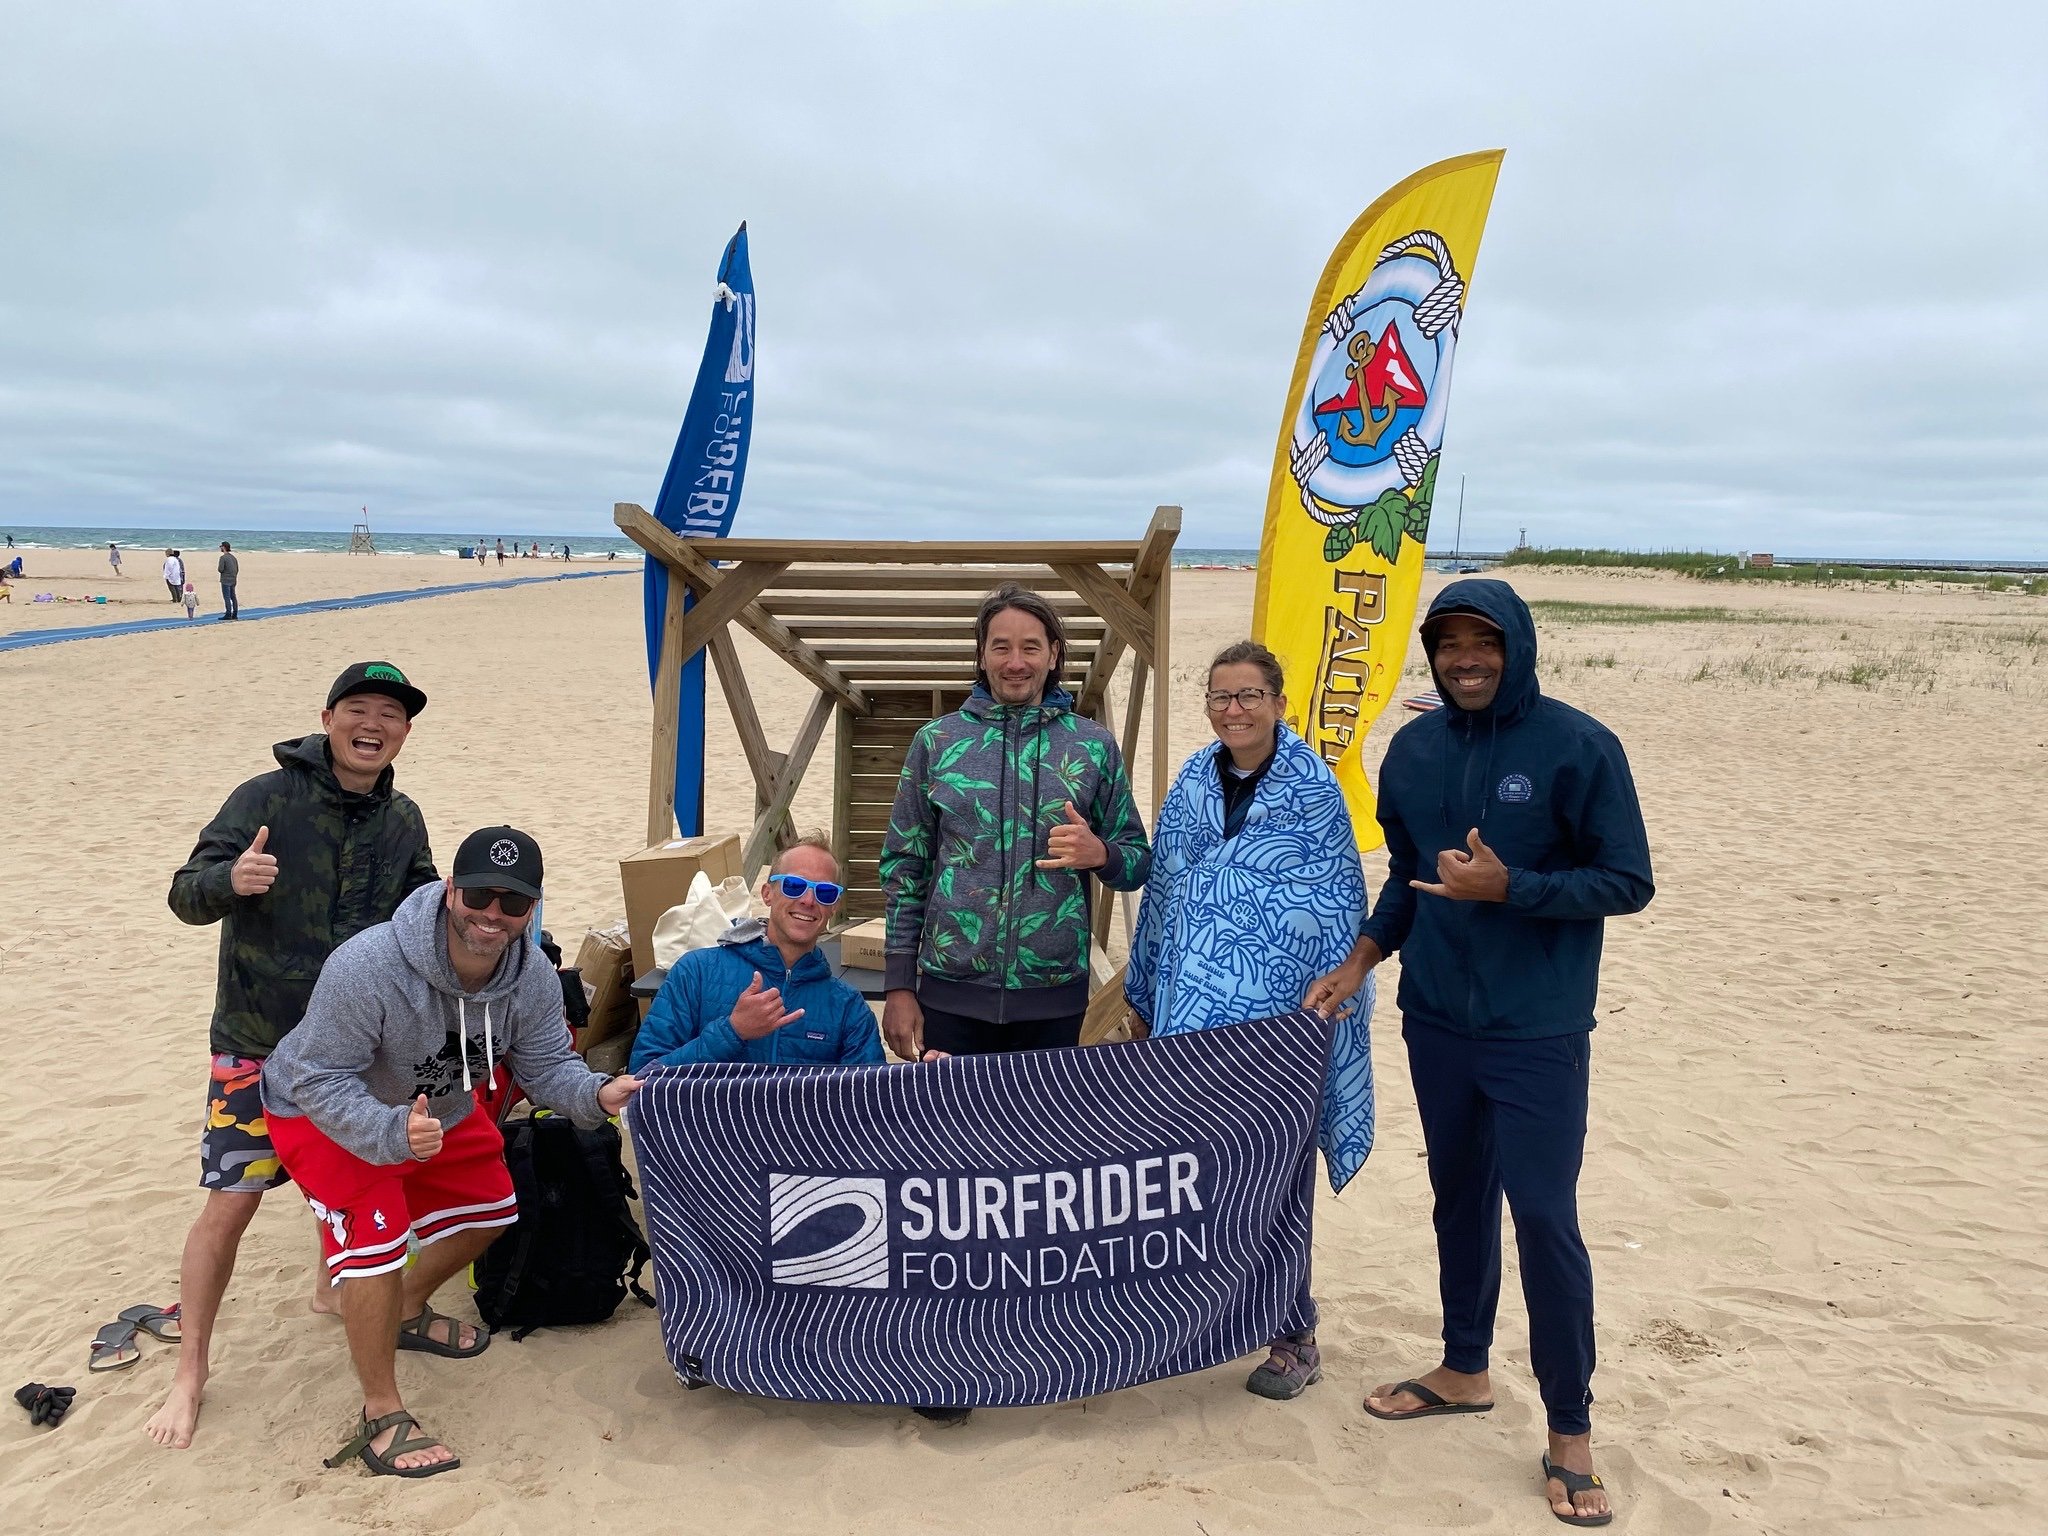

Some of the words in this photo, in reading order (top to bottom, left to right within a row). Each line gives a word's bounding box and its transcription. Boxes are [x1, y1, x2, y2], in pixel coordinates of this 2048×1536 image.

[1320, 569, 1386, 774] PACIFI
[900, 1151, 1203, 1242] SURFRIDER
[902, 1222, 1208, 1290] FOUNDATION
